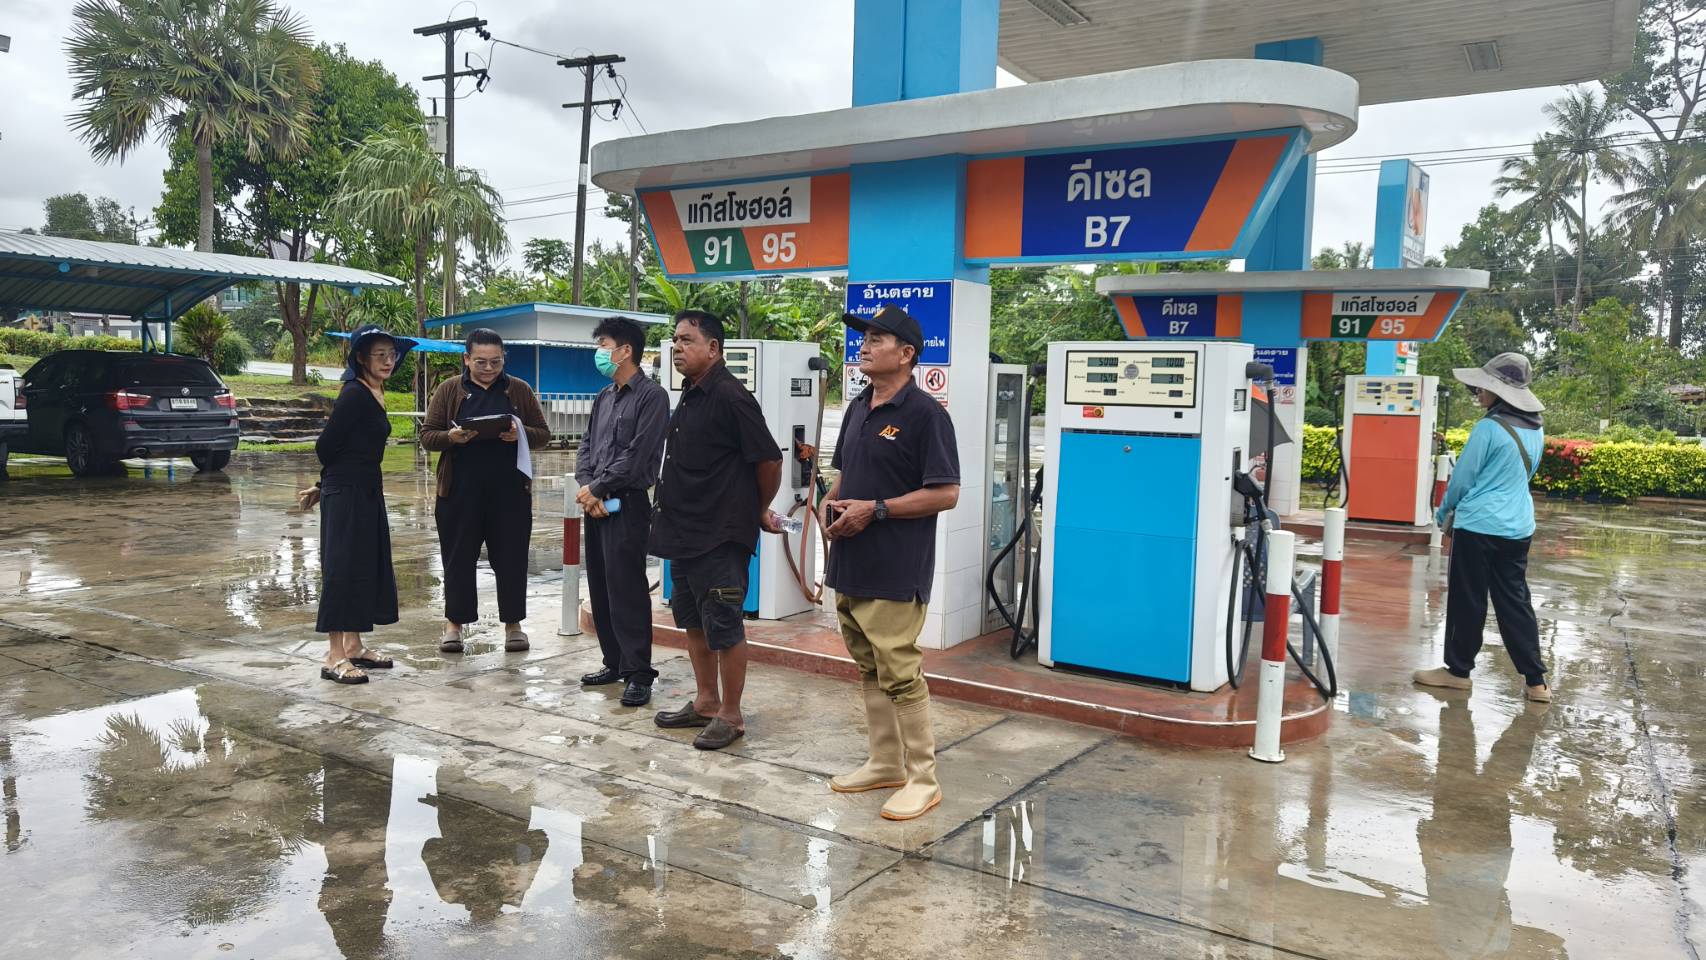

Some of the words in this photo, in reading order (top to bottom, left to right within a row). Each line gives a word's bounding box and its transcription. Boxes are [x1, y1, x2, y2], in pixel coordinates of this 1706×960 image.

[1067, 158, 1152, 201] ดีเซล
[687, 186, 793, 224] แก๊สโซฮอล์
[1085, 215, 1132, 248] B7
[704, 235, 733, 266] 91
[762, 231, 797, 264] 95
[862, 283, 934, 299] อันตราย
[1162, 298, 1198, 316] ดีเซล
[1341, 295, 1419, 313] แก๊สโซฮอล์
[1169, 320, 1190, 335] B7
[1338, 318, 1361, 335] 91
[1381, 318, 1406, 335] 95
